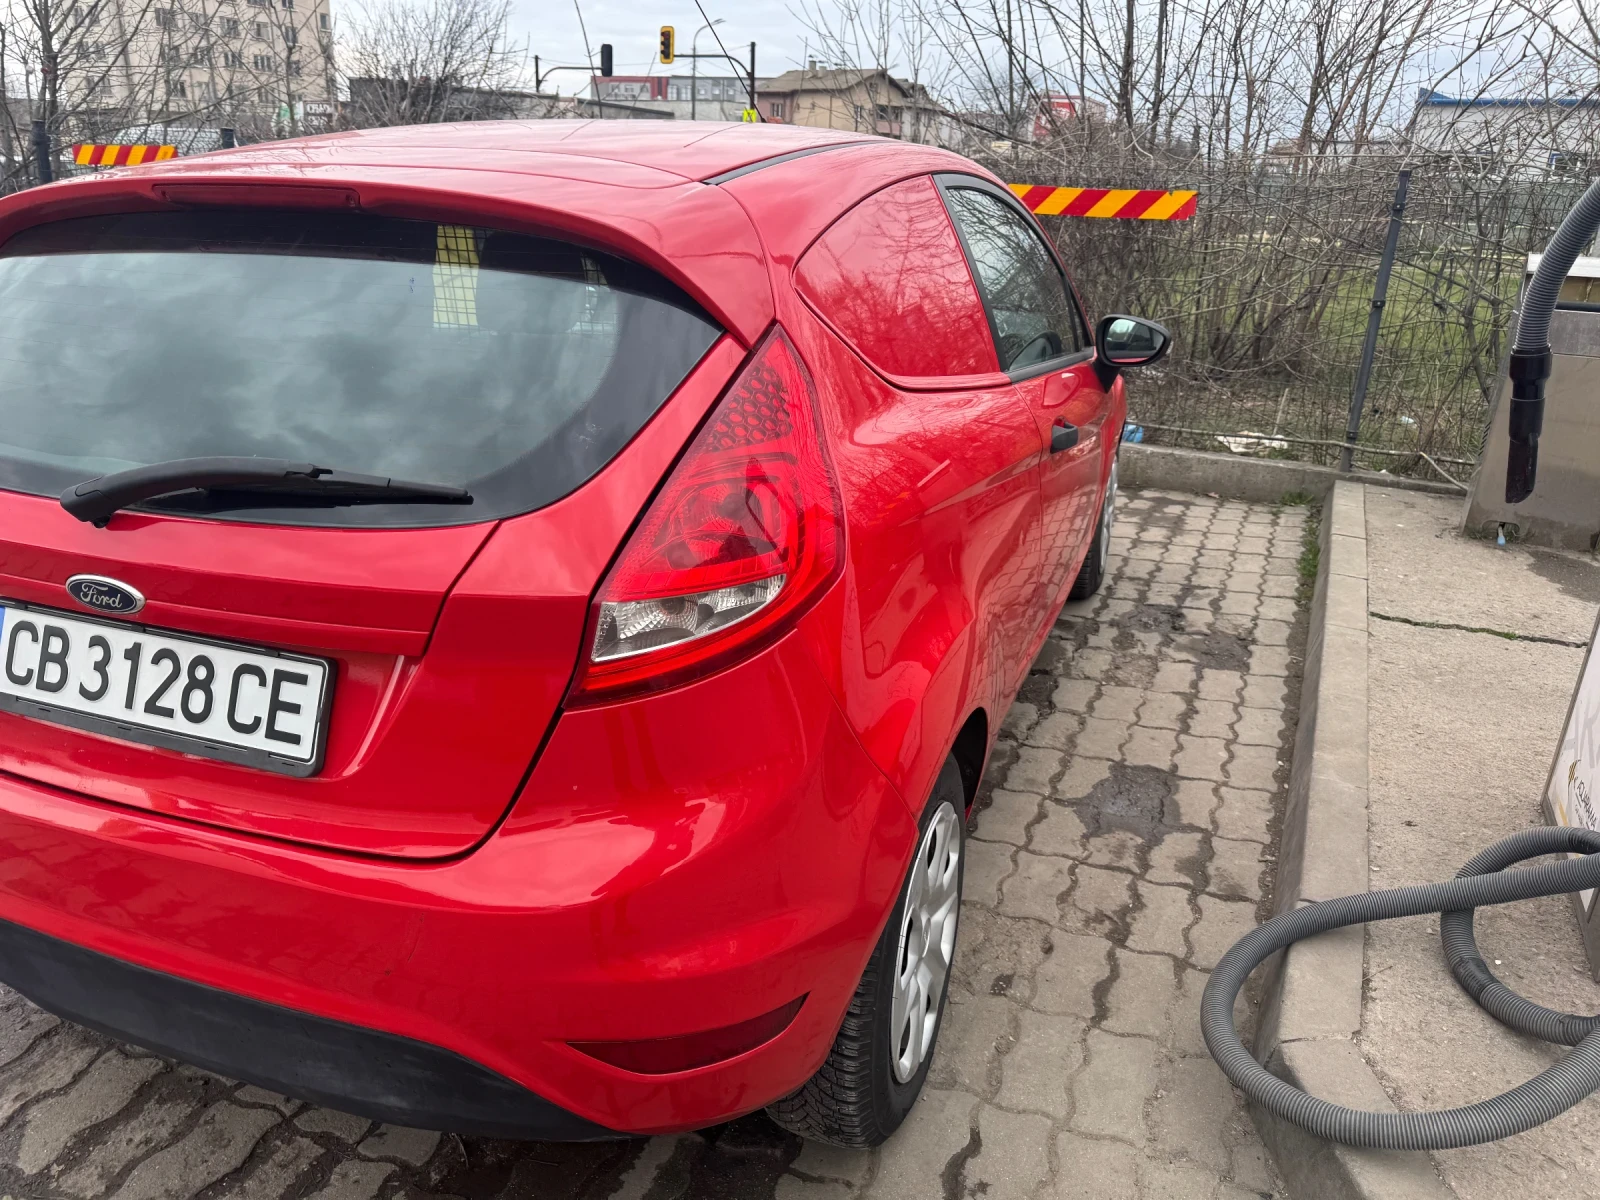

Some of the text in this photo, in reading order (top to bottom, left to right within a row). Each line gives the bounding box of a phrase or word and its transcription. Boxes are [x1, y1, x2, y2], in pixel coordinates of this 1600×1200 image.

[80, 582, 123, 608] Ford
[5, 620, 309, 745] CB 3128 CE
